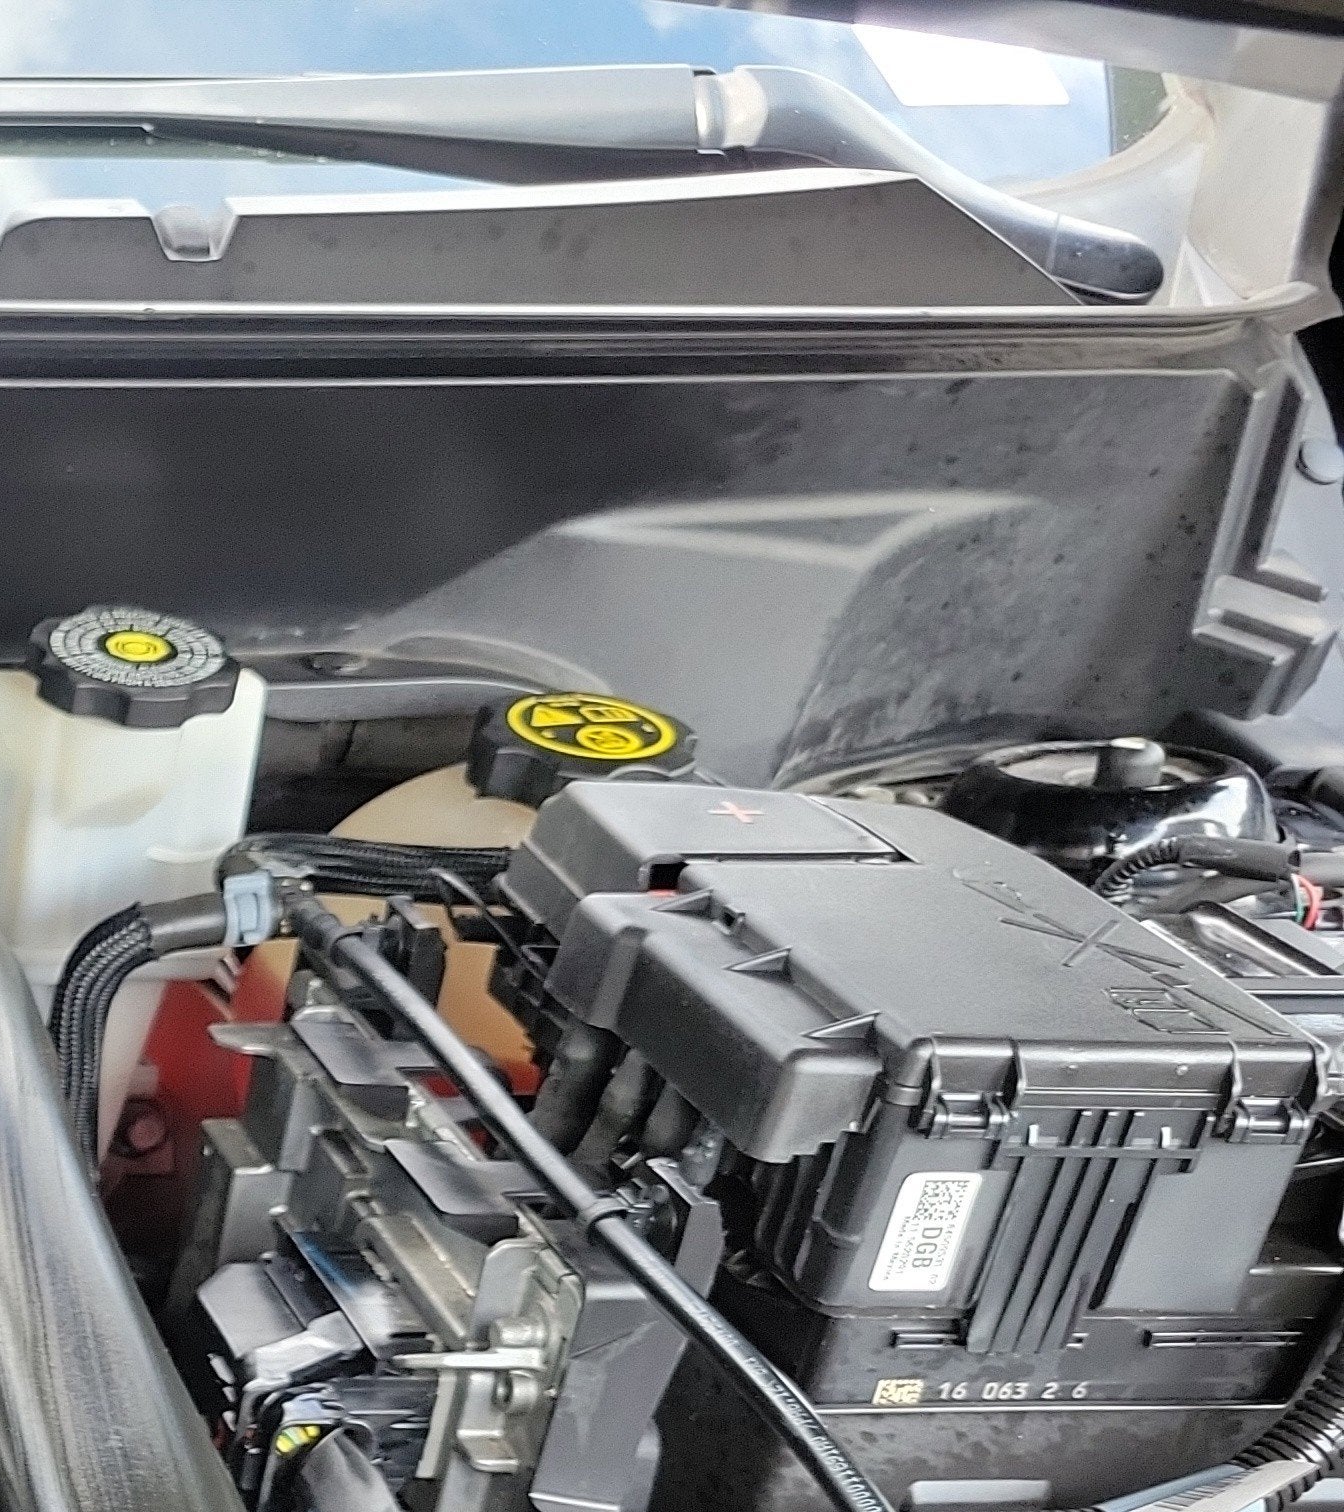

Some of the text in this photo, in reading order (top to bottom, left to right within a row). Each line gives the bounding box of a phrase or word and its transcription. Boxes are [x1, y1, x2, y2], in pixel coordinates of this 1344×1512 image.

[912, 1227, 944, 1269] DGB
[937, 1381, 969, 1400] 16
[981, 1381, 1031, 1401] 063
[1071, 1381, 1091, 1399] 6
